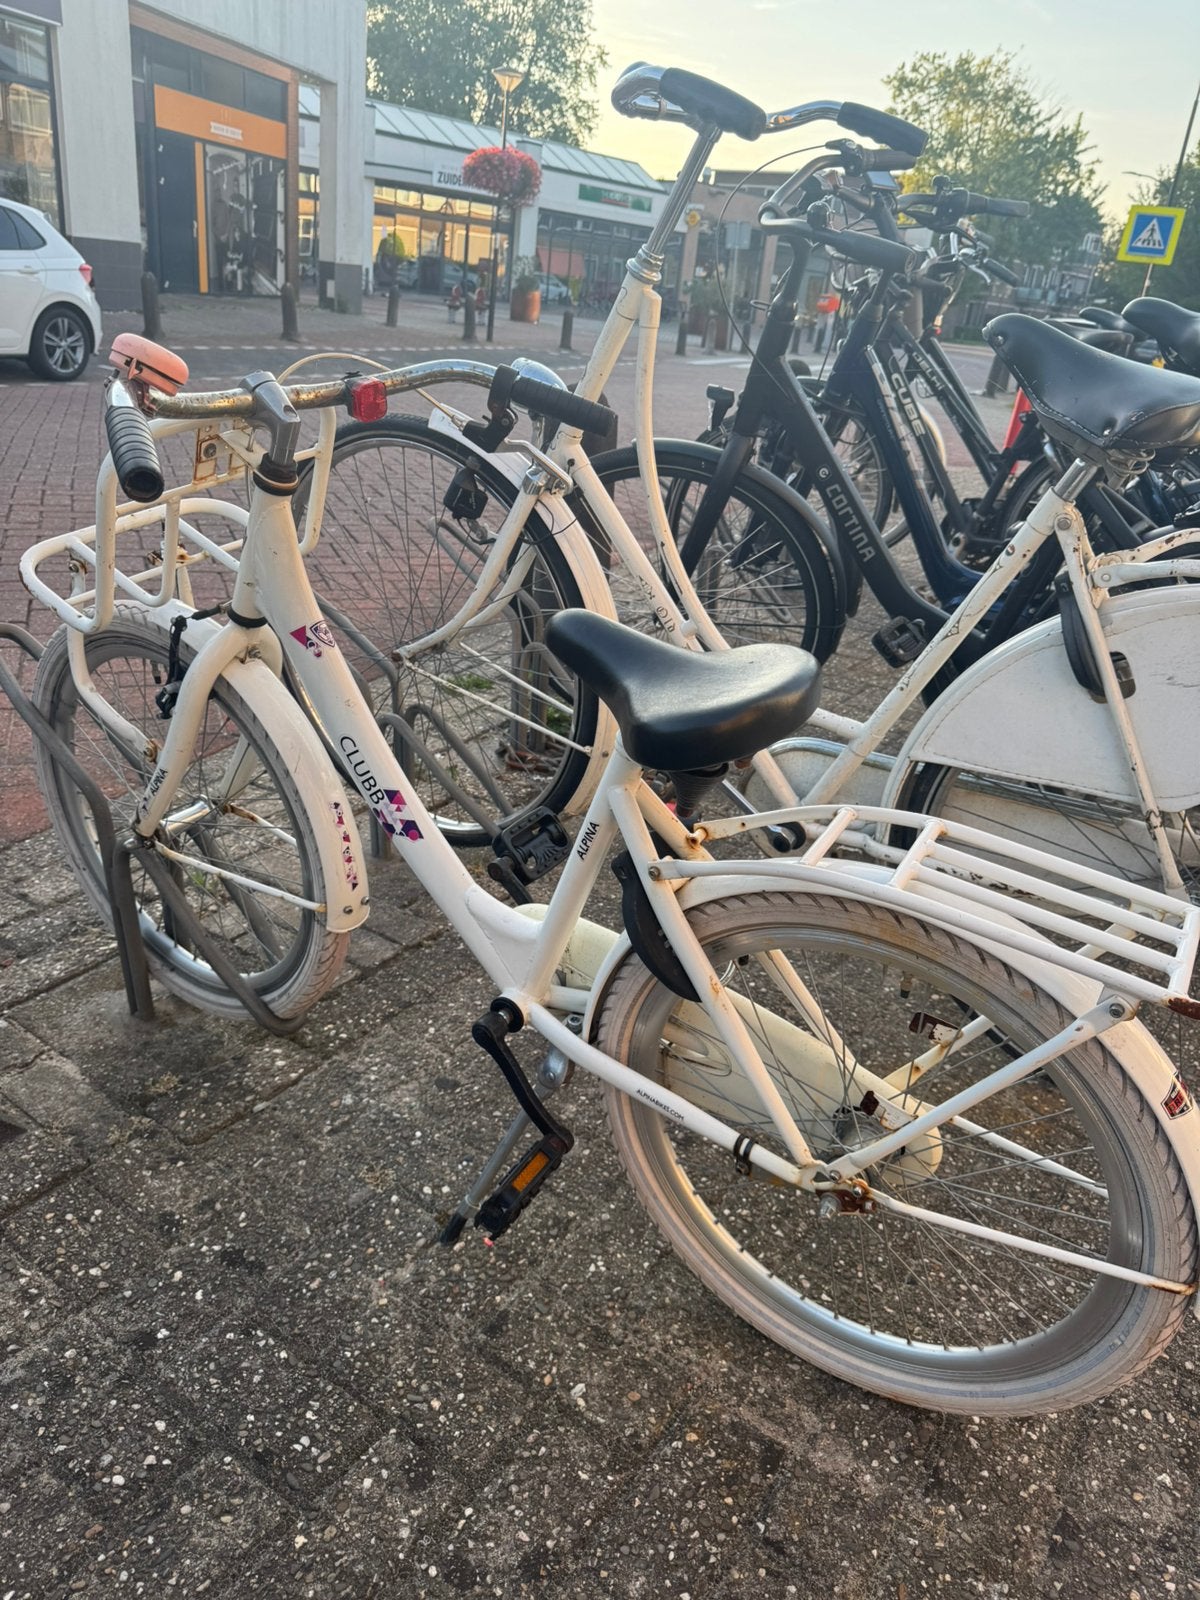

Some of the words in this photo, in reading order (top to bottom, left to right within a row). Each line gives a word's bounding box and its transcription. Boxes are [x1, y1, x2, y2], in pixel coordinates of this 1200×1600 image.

[437, 170, 463, 187] ZUIDE
[891, 372, 926, 436] CUBE
[825, 484, 876, 562] CORTINA
[150, 768, 169, 797] ALPINA
[340, 736, 385, 805] CLUBB
[576, 821, 600, 861] ALPINA
[636, 1089, 684, 1120] ALPINABIKES.COM
